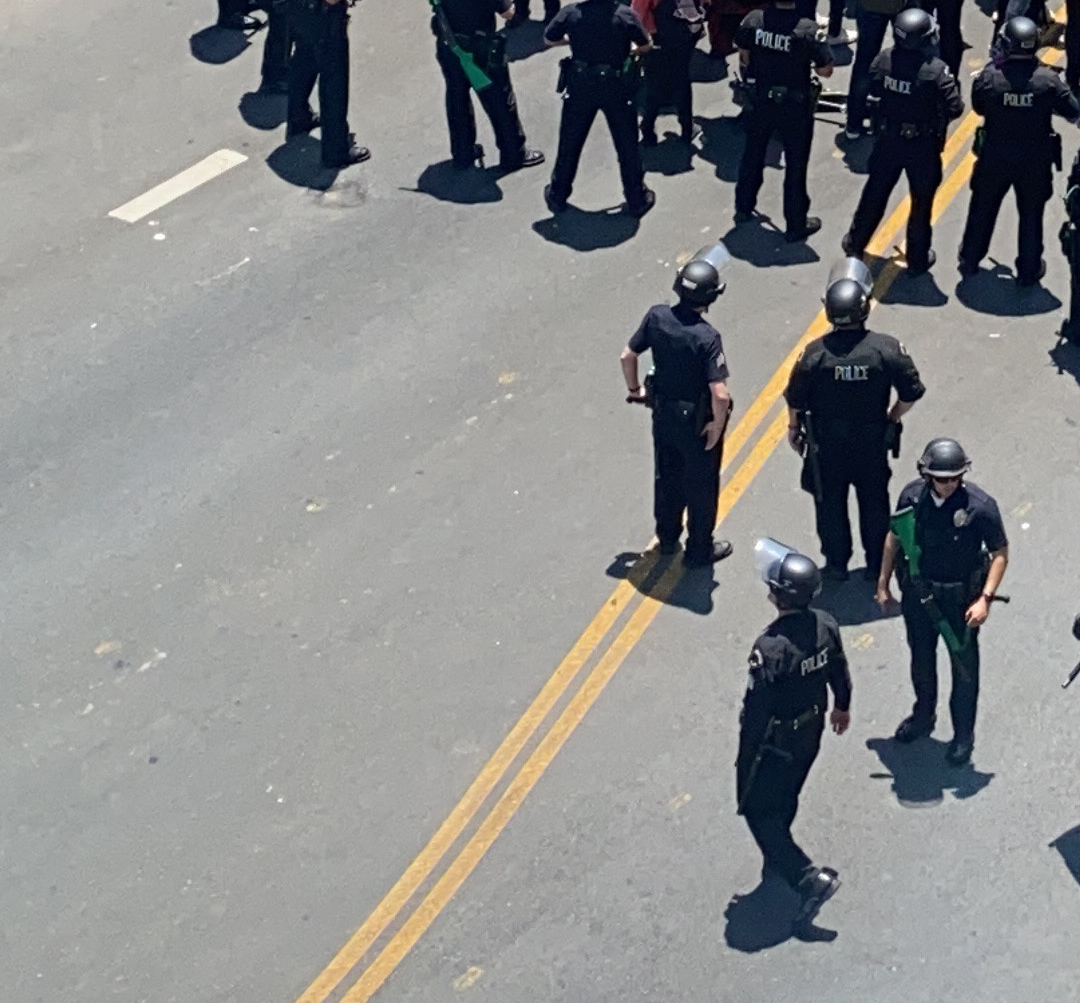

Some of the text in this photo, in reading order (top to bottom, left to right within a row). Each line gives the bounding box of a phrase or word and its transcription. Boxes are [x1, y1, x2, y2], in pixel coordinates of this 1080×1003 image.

[755, 28, 791, 53] POLICE
[884, 75, 912, 95] POLICE
[1003, 92, 1034, 107] POLICE
[833, 365, 868, 381] POLICE
[800, 647, 829, 676] POLICE
